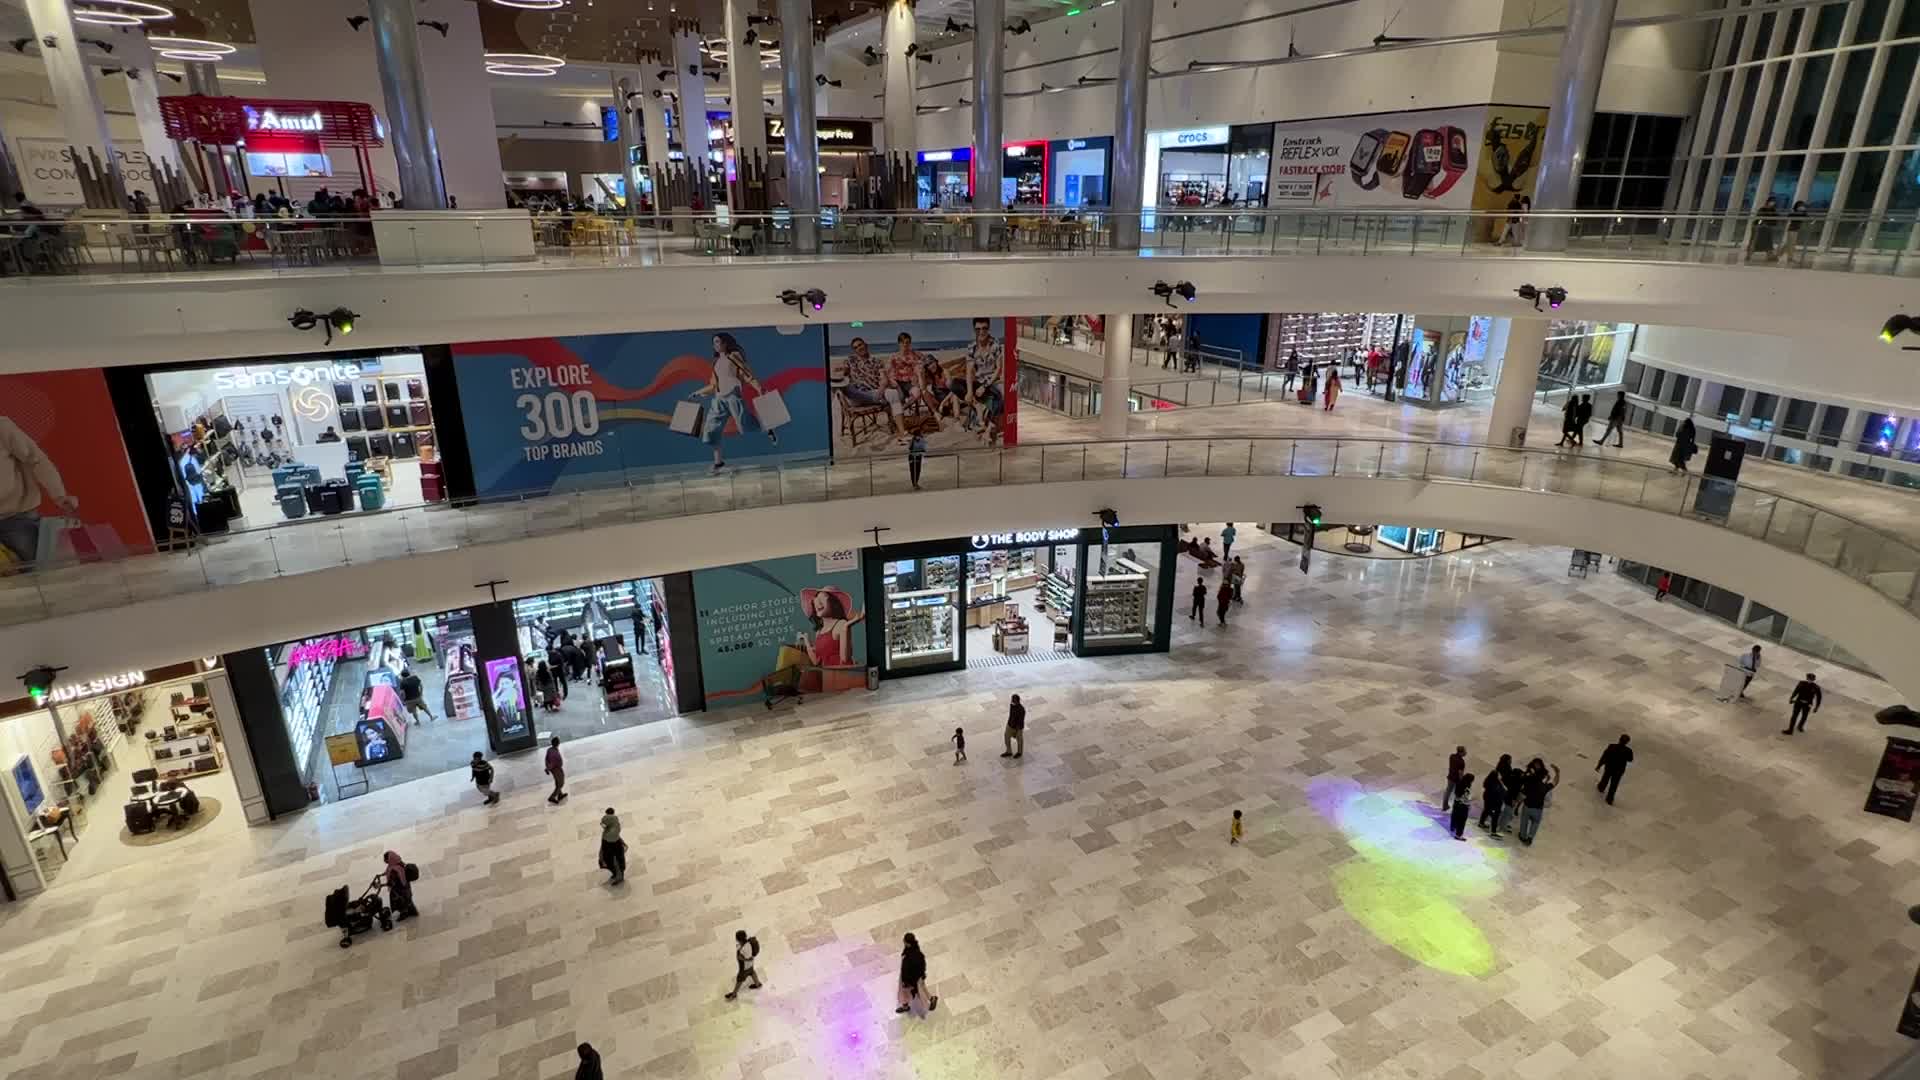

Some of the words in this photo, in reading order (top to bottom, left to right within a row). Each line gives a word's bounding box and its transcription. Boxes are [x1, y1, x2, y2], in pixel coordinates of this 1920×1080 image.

[261, 108, 323, 130] Amul
[1178, 132, 1208, 143] crocs
[1283, 136, 1322, 146] fastrack
[1280, 146, 1320, 160] REFLEX
[1322, 146, 1340, 157] VOX
[1280, 165, 1318, 176] FASTRACK
[1320, 164, 1345, 175] STORE
[214, 364, 361, 390] Samsonite
[511, 364, 593, 389] EXPLORE
[516, 390, 600, 441] 300
[523, 445, 550, 462] TOP
[552, 440, 604, 459] BRANDS
[990, 533, 1014, 545] THE
[1015, 530, 1046, 543] BODY
[1047, 528, 1079, 541] SHOP
[706, 610, 766, 625] INCLUDING
[769, 605, 795, 617] LULU
[713, 602, 758, 616] ANCHOR
[761, 595, 800, 609] STORES
[709, 632, 751, 645] SPREAD
[755, 625, 794, 637] ACROSS
[713, 615, 790, 635] HYPERMARKET
